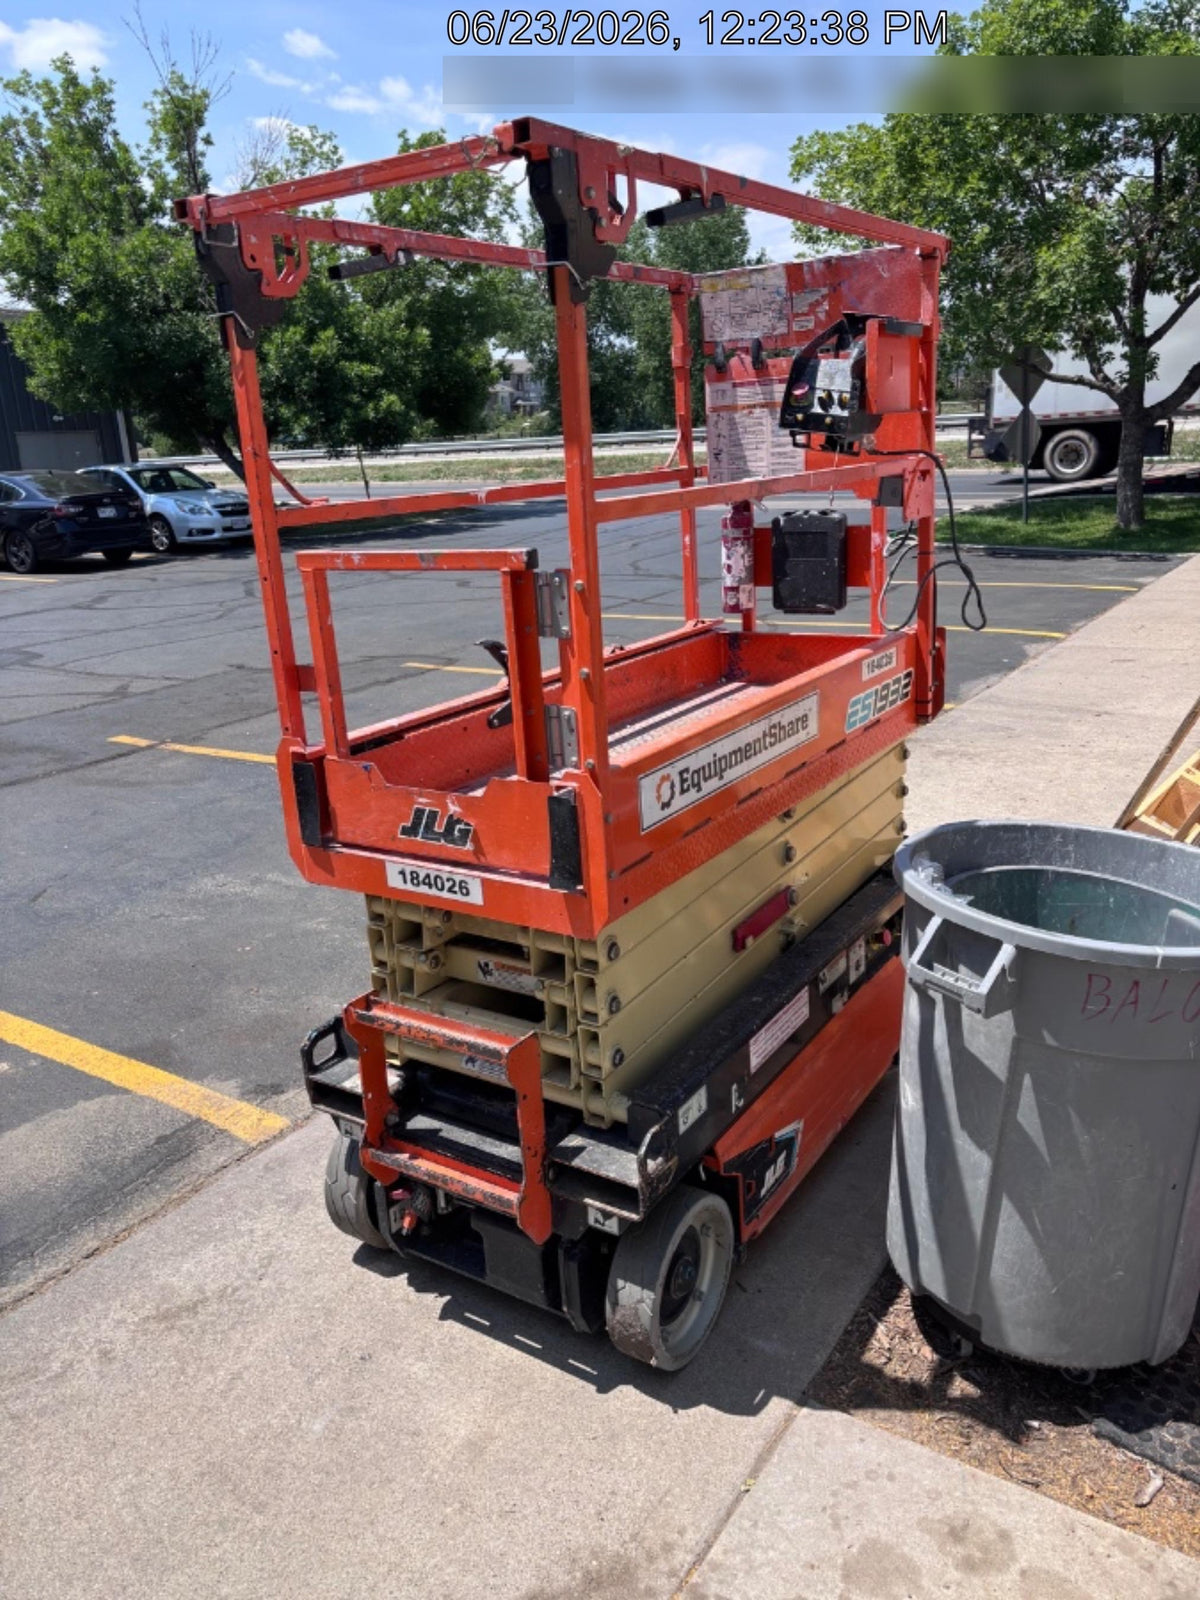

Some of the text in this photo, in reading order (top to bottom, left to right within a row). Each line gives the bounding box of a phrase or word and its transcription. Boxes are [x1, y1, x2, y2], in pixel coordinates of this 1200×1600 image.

[846, 670, 913, 732] ES1932
[678, 712, 809, 795] EquipmentShare
[399, 806, 474, 848] JLG
[398, 868, 470, 897] 184026
